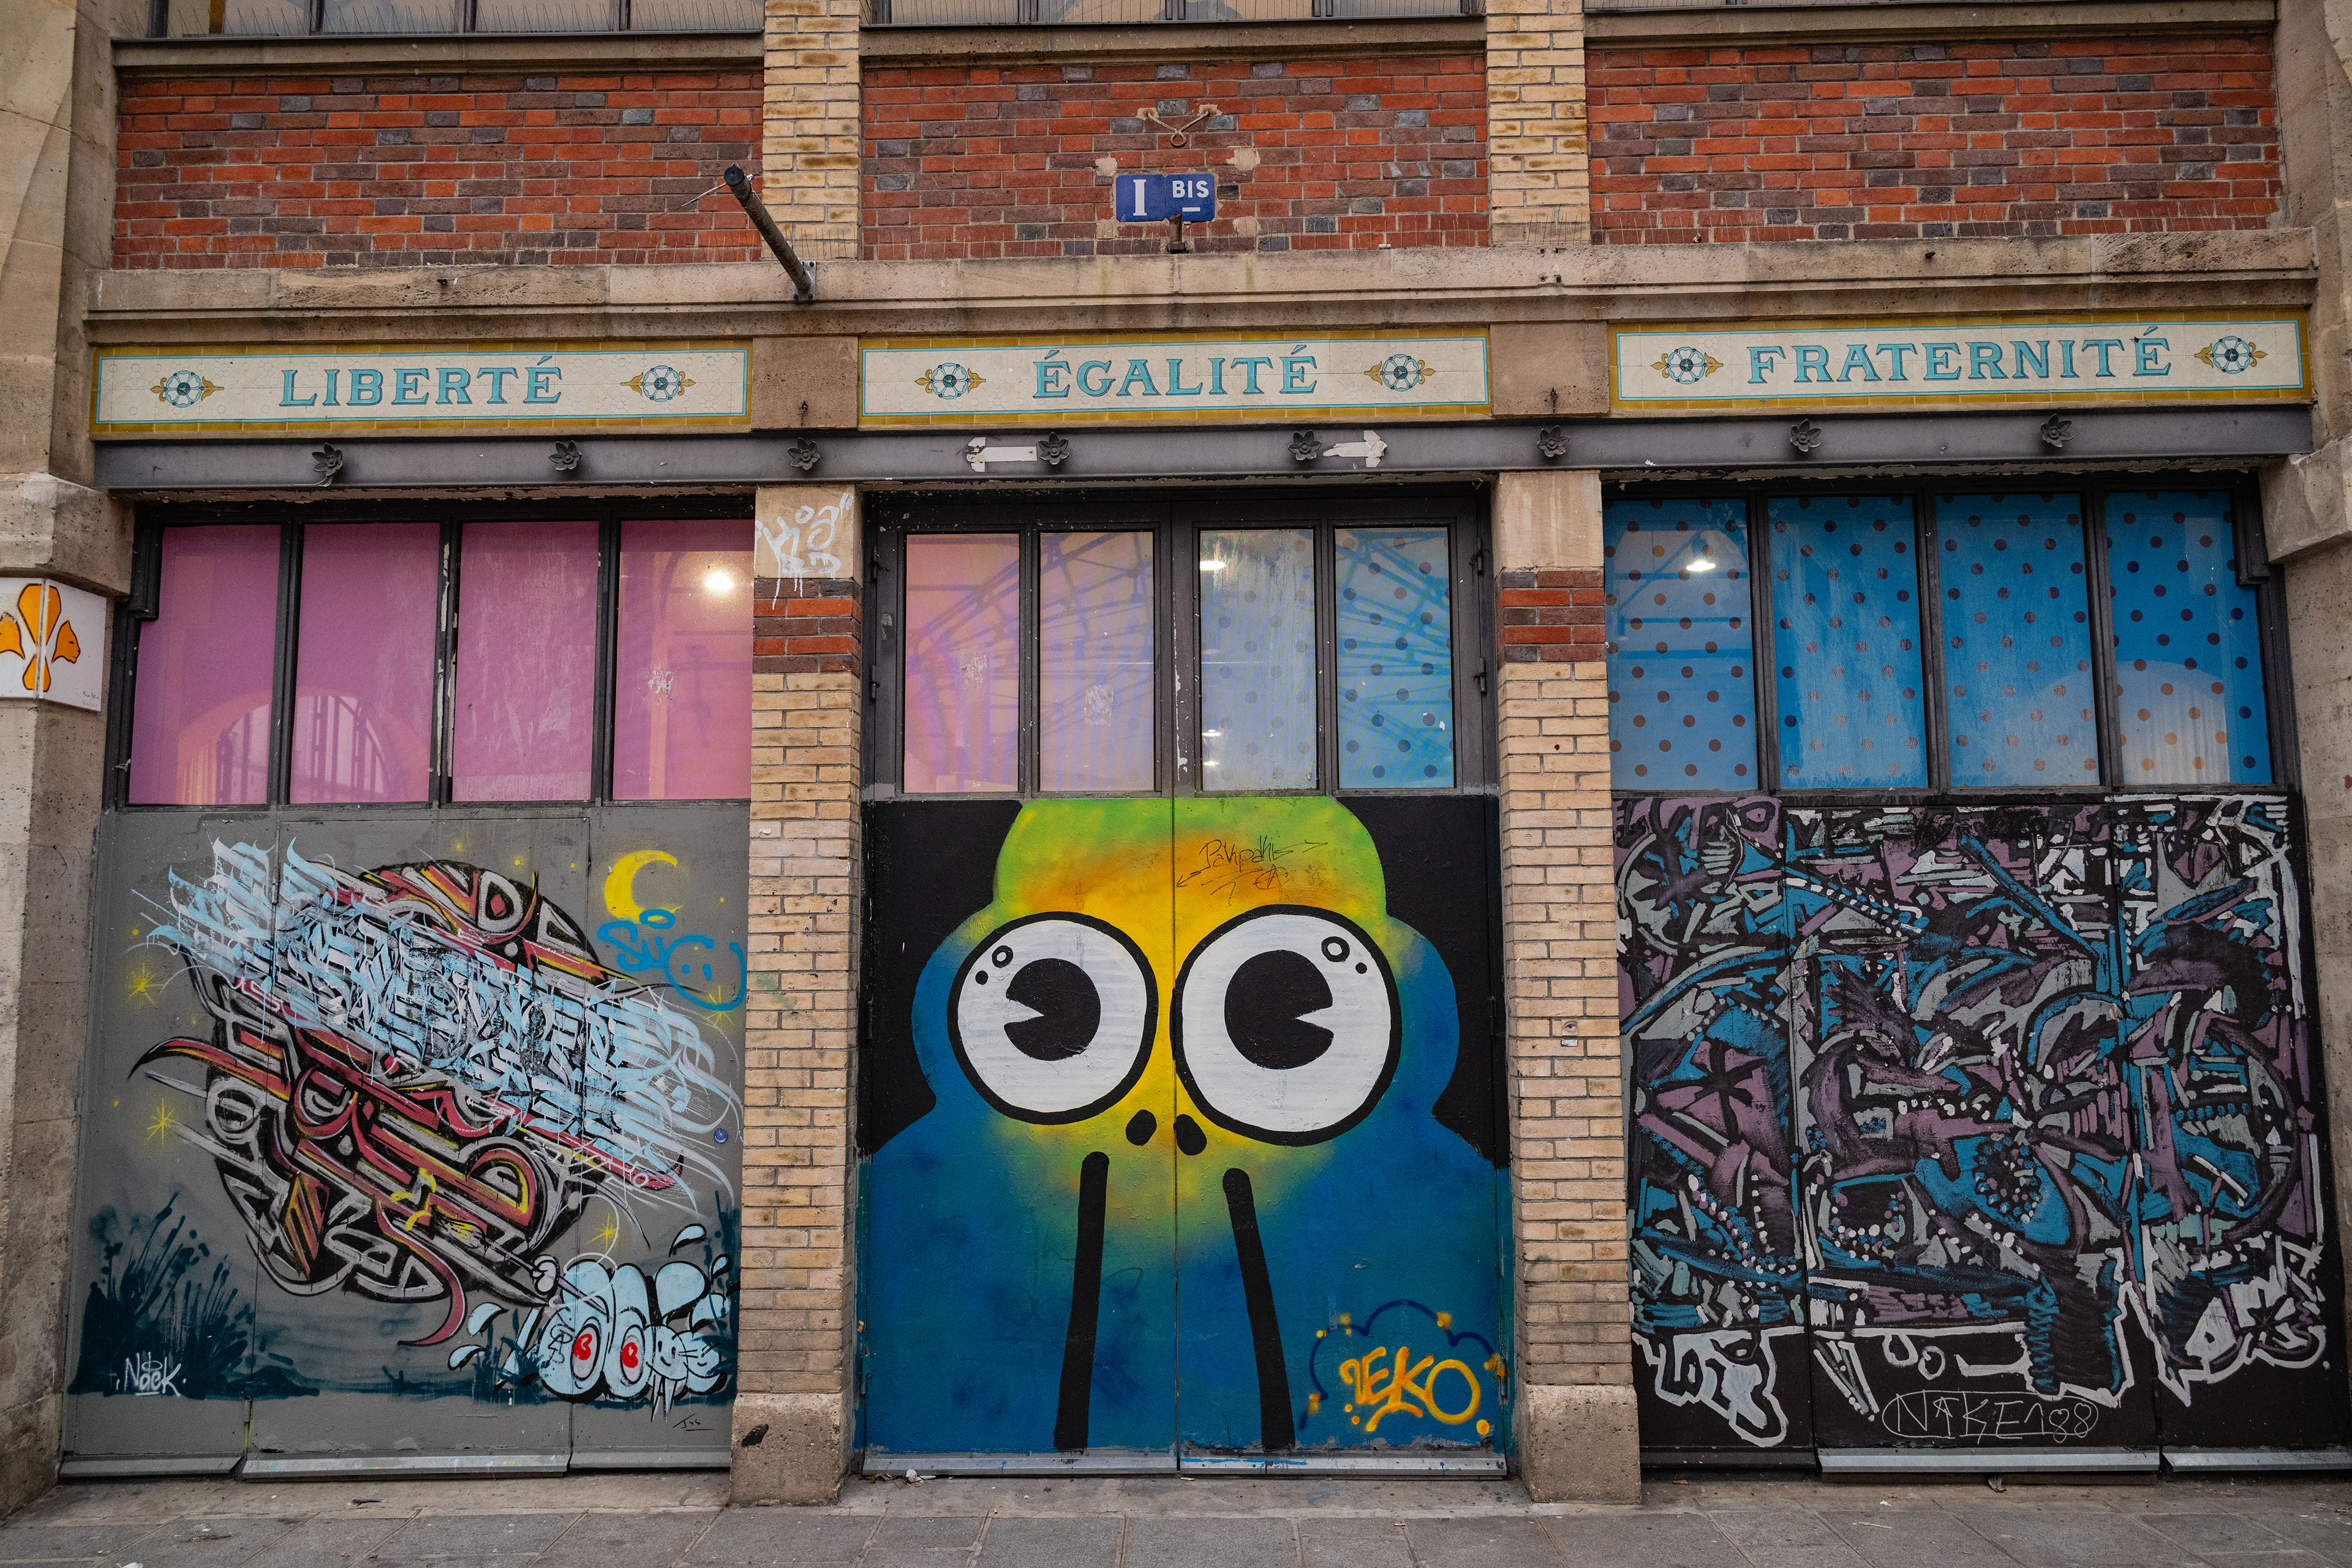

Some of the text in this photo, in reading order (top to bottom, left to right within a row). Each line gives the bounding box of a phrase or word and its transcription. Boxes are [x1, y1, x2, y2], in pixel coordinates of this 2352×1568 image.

[1172, 180, 1209, 198] BIS
[1033, 344, 1318, 398] ÉGALITÉ
[1747, 326, 2172, 383] FRATERNITÉ
[279, 356, 562, 406] LIBERTÉ
